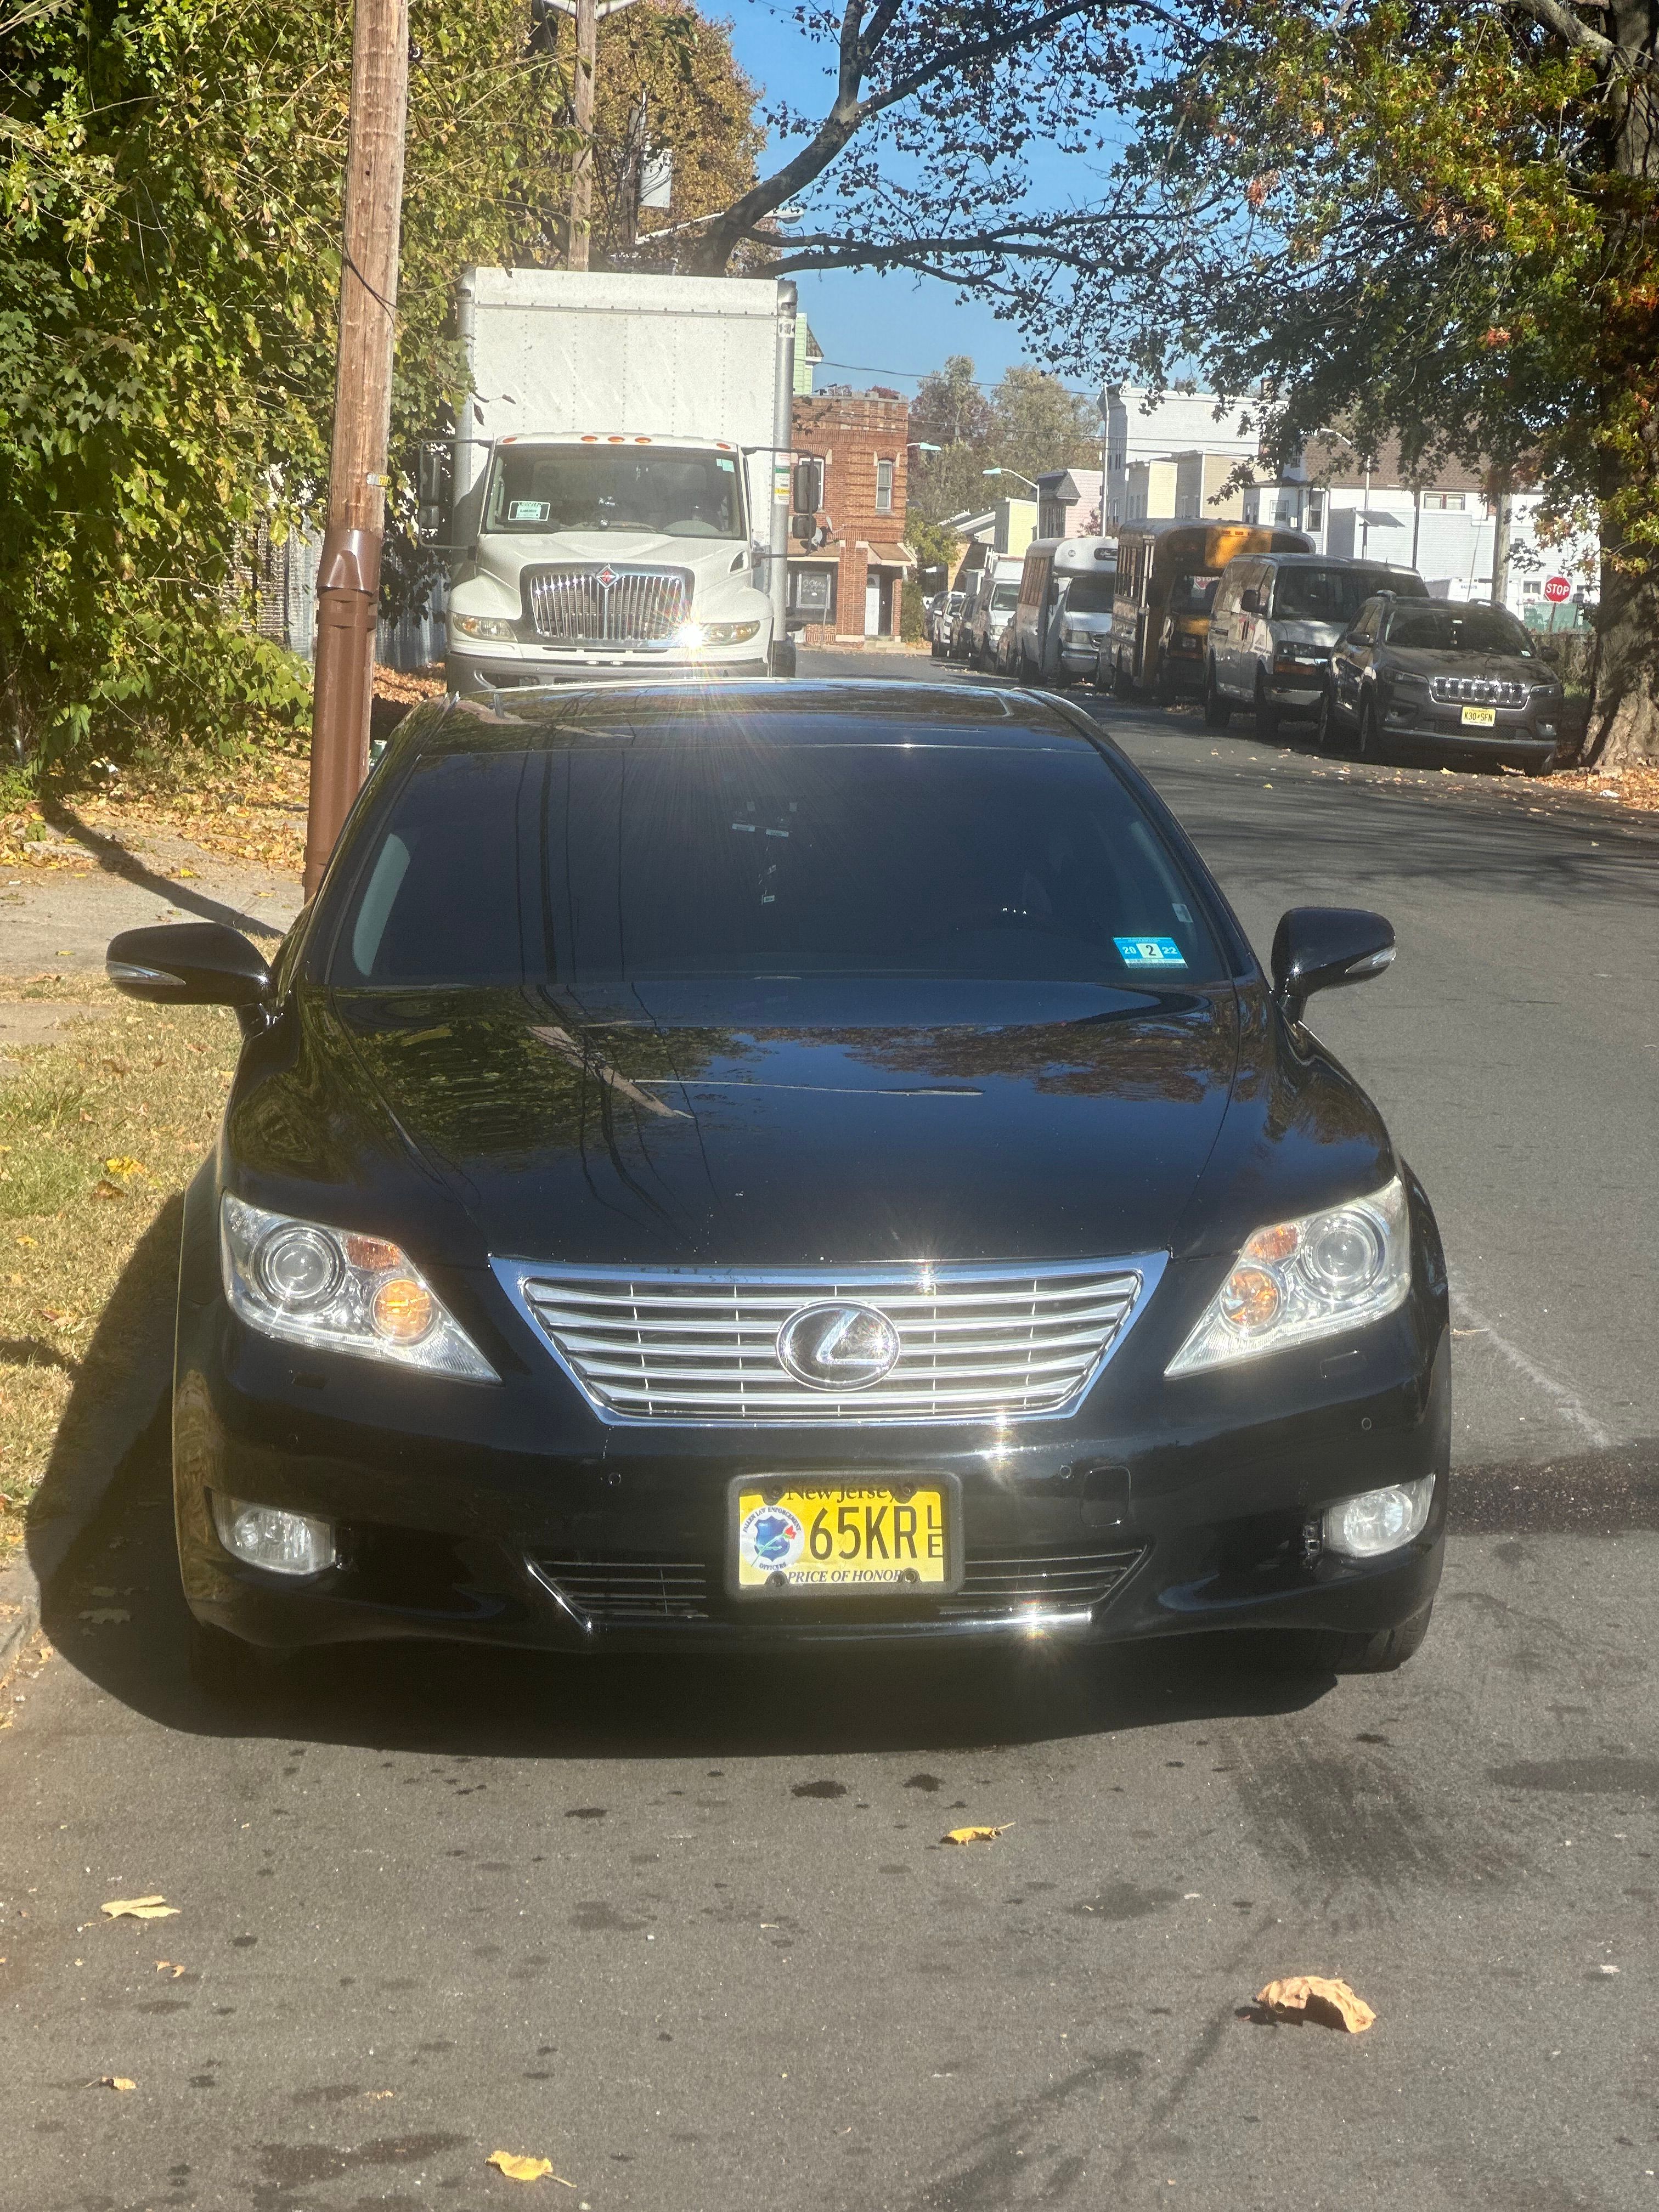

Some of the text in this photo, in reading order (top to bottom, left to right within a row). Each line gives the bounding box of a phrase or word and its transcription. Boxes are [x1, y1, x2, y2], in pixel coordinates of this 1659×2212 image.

[1546, 583, 1569, 595] STOP
[1146, 945, 1156, 956] 2
[787, 1483, 833, 1500] New
[743, 1507, 802, 1533] FALLEN LAW ENFORCEMENT
[810, 1505, 917, 1560] 65KR
[759, 1561, 787, 1571] OFFICERS
[788, 1571, 828, 1583] PRICE
[831, 1570, 850, 1582] OF
